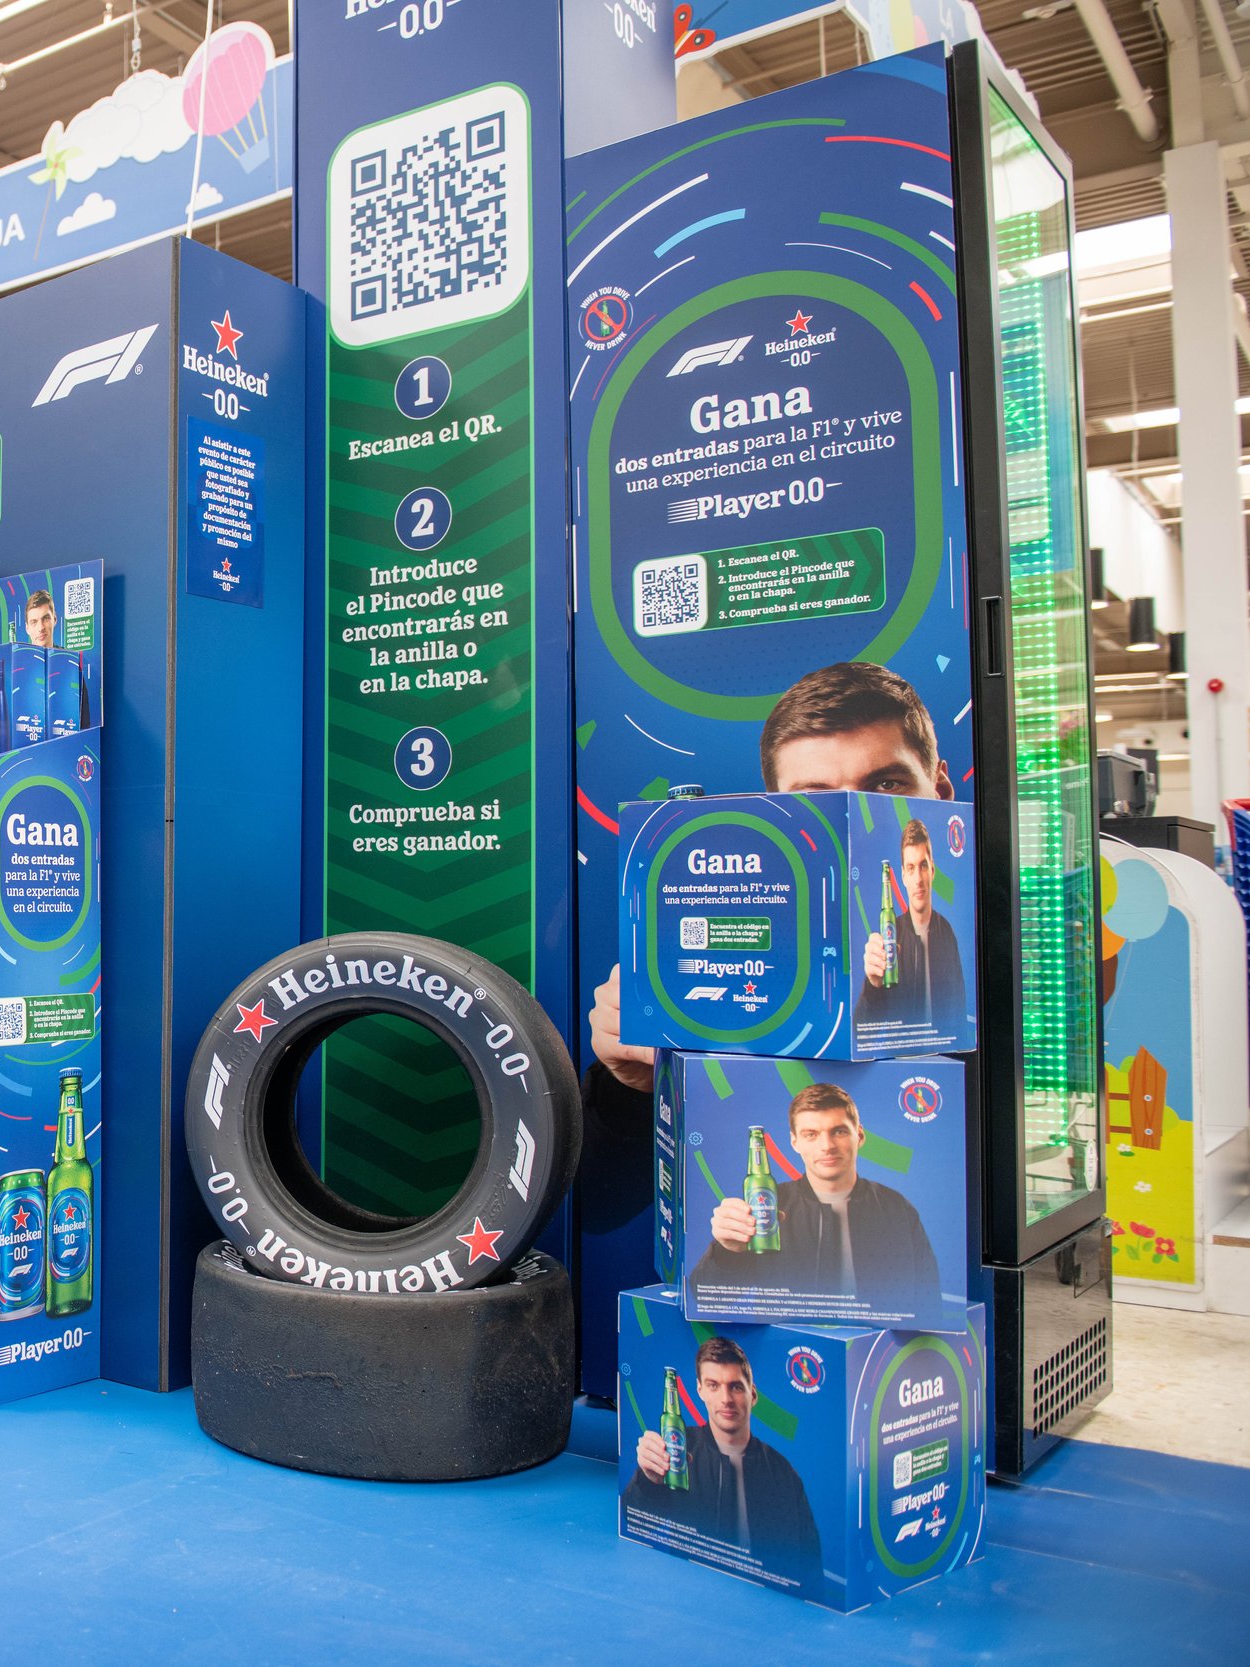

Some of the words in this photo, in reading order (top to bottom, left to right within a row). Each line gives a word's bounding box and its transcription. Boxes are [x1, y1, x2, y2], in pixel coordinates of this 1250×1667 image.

[580, 291, 599, 309] WHEN
[598, 286, 612, 296] YOU
[612, 286, 630, 301] DRIVE
[585, 339, 605, 351] NEVER
[607, 331, 627, 349] DRINK
[413, 367, 433, 406] 1
[690, 387, 813, 433] Gana
[203, 435, 211, 445] Al
[211, 440, 233, 451] asistir
[237, 448, 251, 457] este
[349, 431, 435, 460] Escanea
[439, 421, 460, 443] el
[464, 414, 502, 442] QR.
[615, 457, 648, 474] dos
[652, 440, 739, 467] entradas
[743, 432, 786, 454] para
[790, 426, 808, 442] la
[843, 419, 856, 436] y
[860, 411, 902, 428] vive
[198, 446, 220, 459] evento
[220, 451, 229, 461] de
[229, 455, 256, 469] carácter
[199, 457, 224, 471] público
[224, 465, 232, 473] es
[232, 467, 254, 479] posible
[626, 477, 658, 493] una
[662, 458, 767, 487] experiencia
[772, 453, 795, 467] en
[799, 444, 816, 462] el
[820, 434, 895, 459] circuito
[411, 498, 434, 537] 2
[696, 489, 786, 520] Player
[370, 558, 478, 586] Introduce
[718, 575, 727, 584] 2.
[728, 570, 778, 583] Introduce
[779, 567, 790, 576] el
[791, 561, 833, 575] Pincode
[834, 558, 855, 570] que
[346, 595, 365, 616] el
[370, 585, 457, 613] Pincode
[462, 583, 504, 606] que
[719, 610, 728, 619] 3.
[729, 604, 787, 618] Comprueba
[789, 601, 798, 611] si
[800, 600, 823, 610] eres
[824, 594, 871, 609] ganador.
[342, 609, 475, 642] encontrarás
[480, 610, 509, 627] en
[370, 647, 390, 666] la
[395, 640, 459, 664] anilla
[463, 642, 477, 657] o
[360, 678, 386, 694] en
[390, 672, 411, 691] la
[415, 669, 488, 691] chapa.
[411, 738, 435, 776] 3
[349, 801, 476, 827] Comprueba
[481, 799, 501, 820] si
[7, 813, 78, 846] Gana
[353, 837, 398, 852] eres
[403, 830, 501, 856] ganador.
[11, 853, 29, 865] dos
[31, 854, 75, 866] entradas
[688, 849, 762, 875] Gana
[693, 959, 744, 978] Player
[10, 1337, 62, 1362] Player
[899, 1376, 944, 1407] Gana
[902, 1491, 932, 1513] Player
